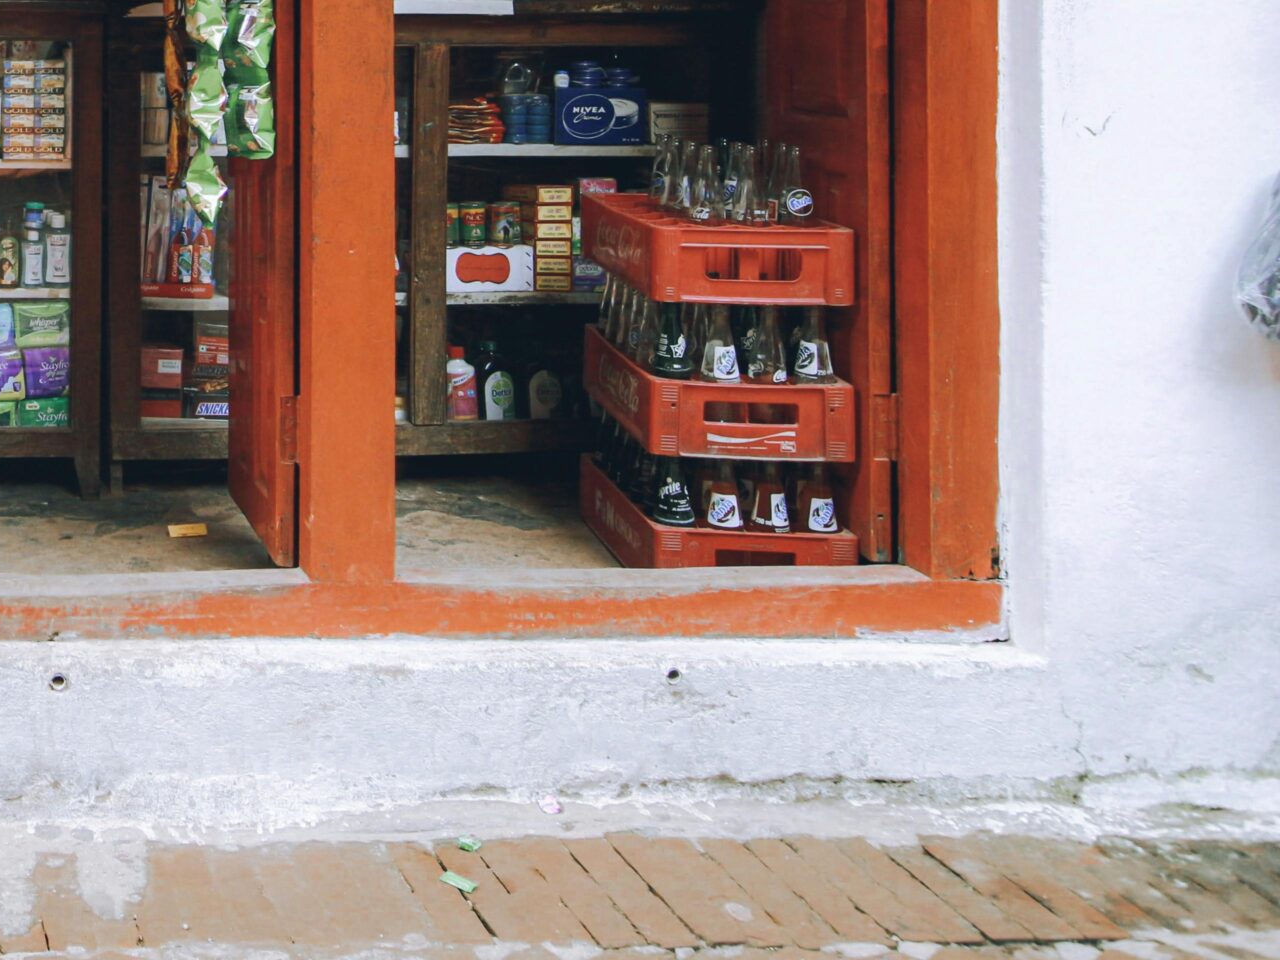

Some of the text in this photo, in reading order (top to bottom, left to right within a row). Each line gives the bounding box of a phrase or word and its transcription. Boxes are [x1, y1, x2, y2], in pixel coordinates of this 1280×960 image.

[491, 389, 512, 397] Dettol
[198, 403, 229, 415] SNICKE
[658, 481, 681, 499] prite
[711, 499, 734, 520] Fanta
[813, 502, 834, 525] Fanta
